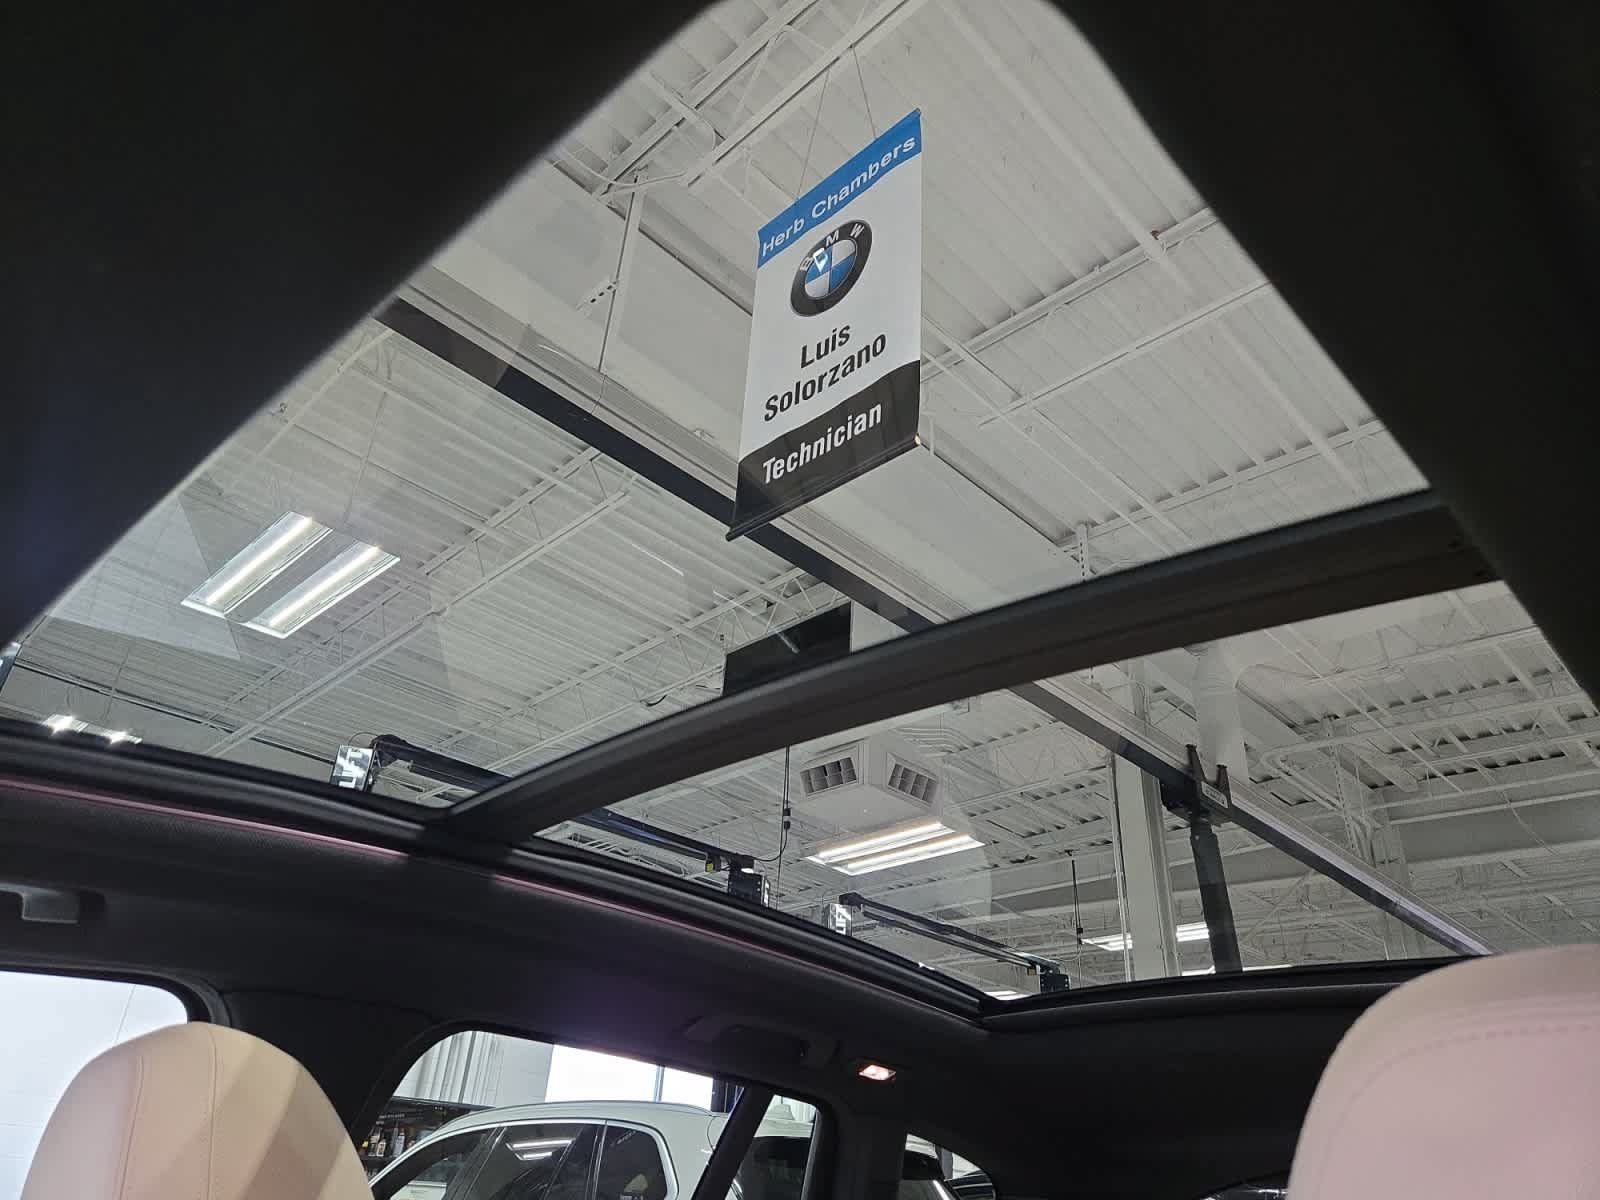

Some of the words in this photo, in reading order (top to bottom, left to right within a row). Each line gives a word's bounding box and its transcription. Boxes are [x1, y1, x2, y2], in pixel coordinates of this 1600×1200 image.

[762, 217, 805, 257] Herb
[811, 137, 916, 219] Chambers
[800, 222, 865, 271] BMW
[764, 333, 887, 422] Solorzano
[800, 325, 851, 369] Luis
[763, 403, 882, 484] Technician
